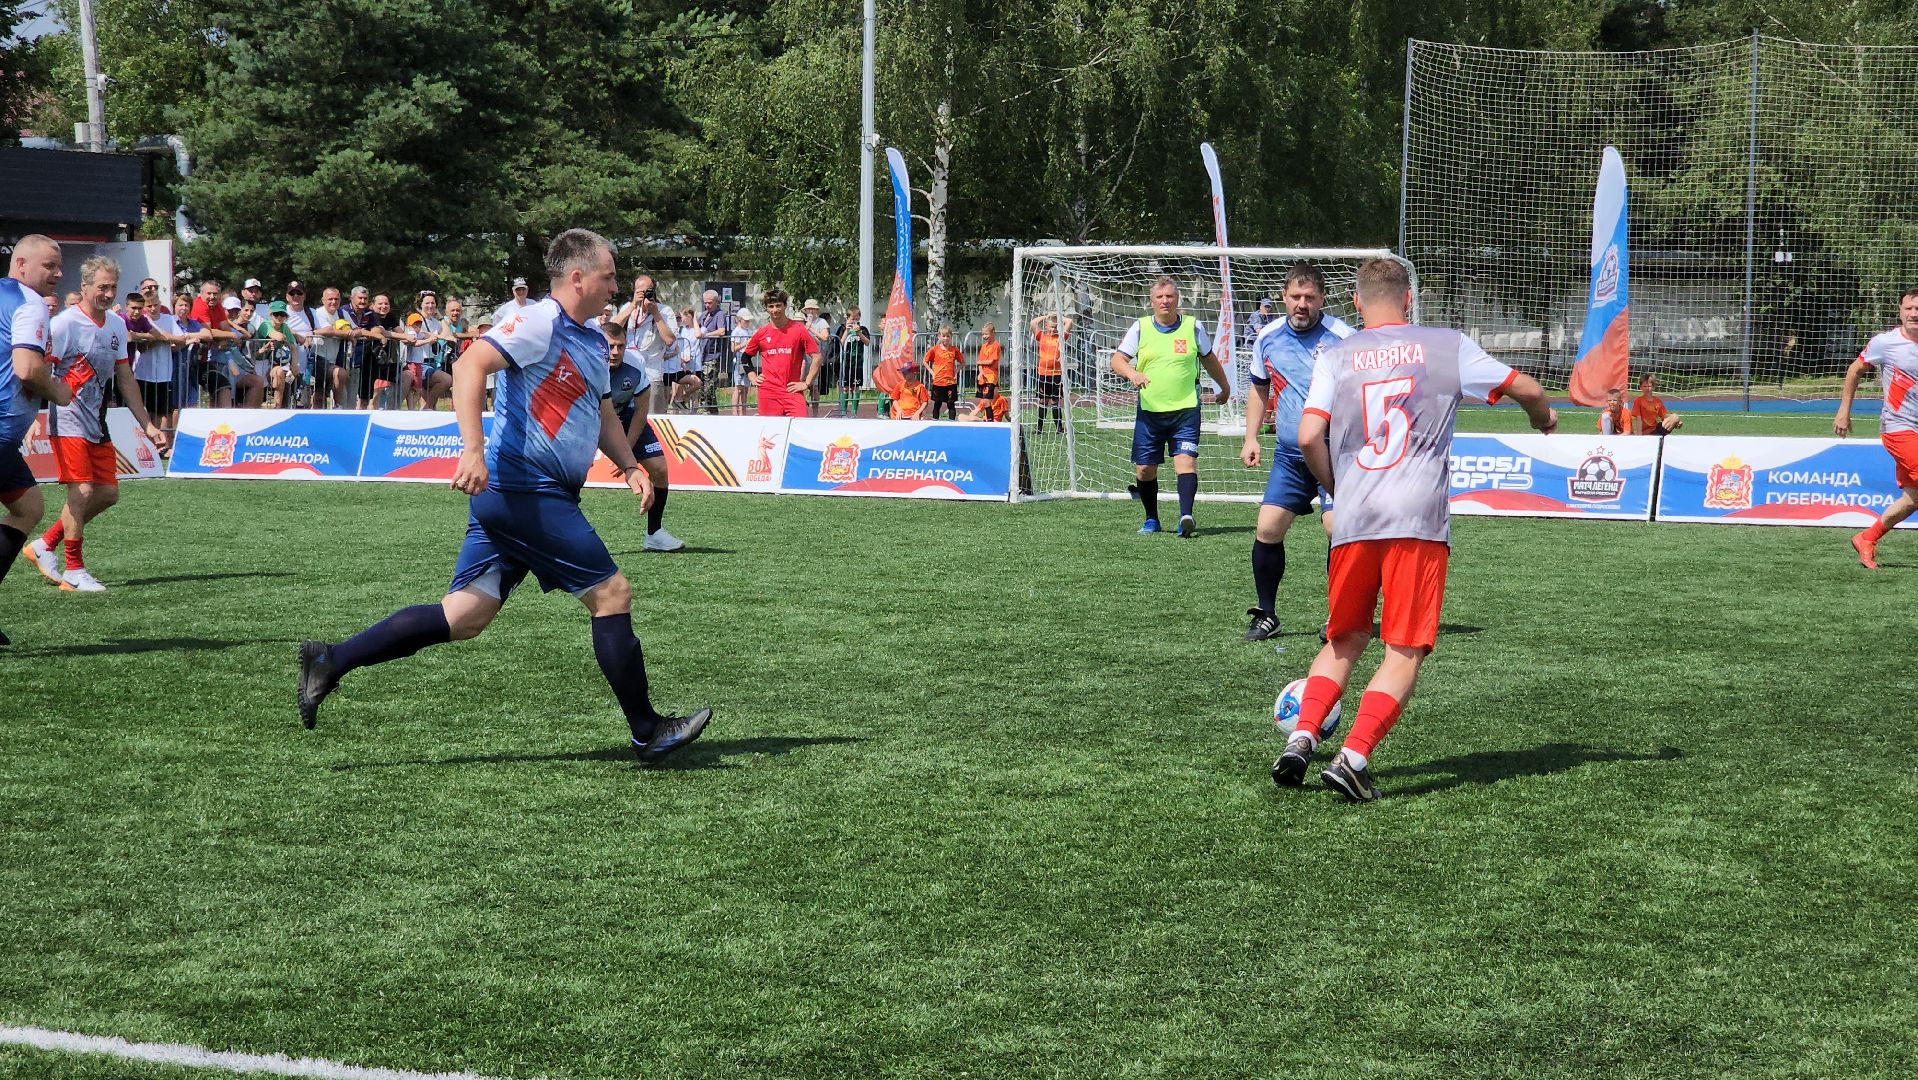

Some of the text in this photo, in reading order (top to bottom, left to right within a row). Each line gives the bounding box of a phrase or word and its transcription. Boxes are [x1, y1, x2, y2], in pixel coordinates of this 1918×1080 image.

[1353, 343, 1425, 372] КАРЯКА
[1356, 375, 1415, 471] 5
[245, 435, 309, 448] КОМАНДА
[242, 452, 330, 465] ГУБЕРНАТОРА
[871, 449, 948, 464] КОМАНДА
[868, 467, 974, 482] ГУБЕРНАТОРА
[1768, 470, 1862, 488] КОМАНДА
[1573, 481, 1619, 492] МАТЧ ЛЕГЕНД
[1765, 492, 1894, 507] ГУБЕРНАТОРА
